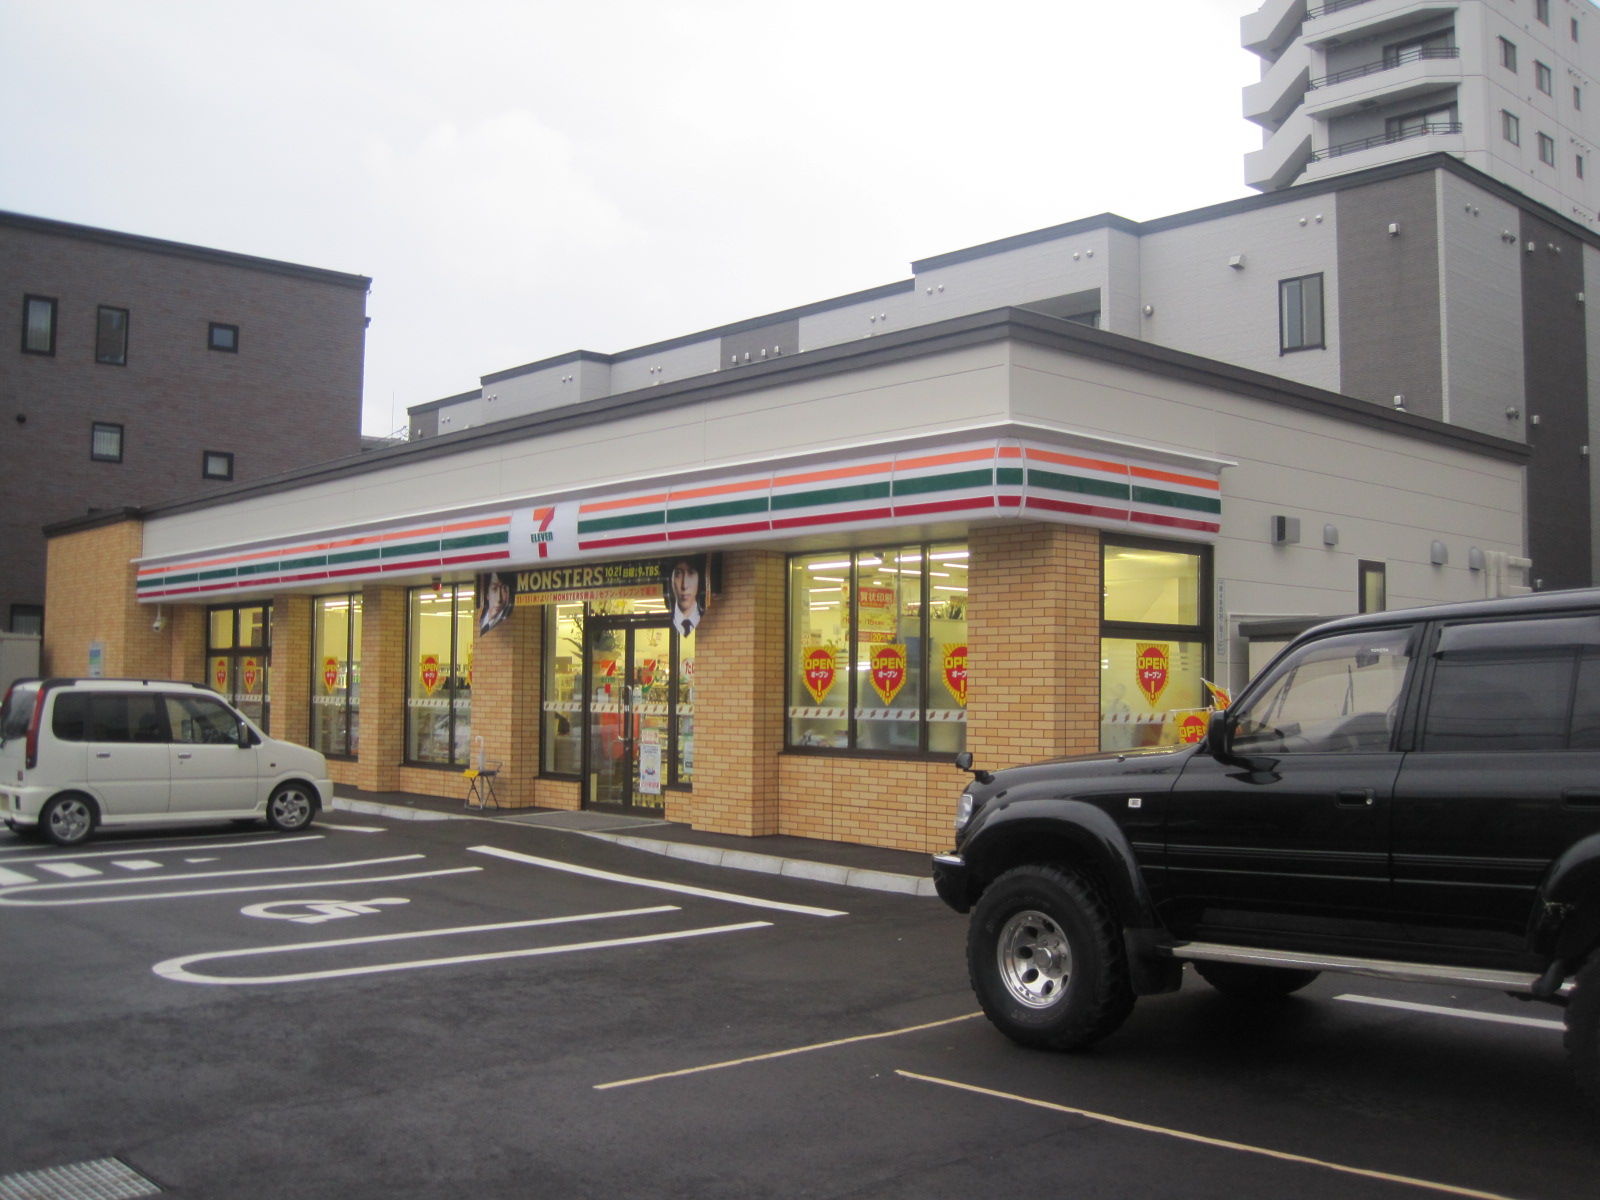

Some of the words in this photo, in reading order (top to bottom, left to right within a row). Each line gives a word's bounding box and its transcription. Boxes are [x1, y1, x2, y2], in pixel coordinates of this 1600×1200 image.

[517, 567, 604, 592] MONSTERS
[804, 657, 835, 670] OPEN
[871, 656, 906, 670] OPEN
[944, 655, 968, 669] OPE
[1137, 656, 1168, 670] OPEN
[951, 669, 967, 679] オープ
[1178, 726, 1206, 738] OPE
